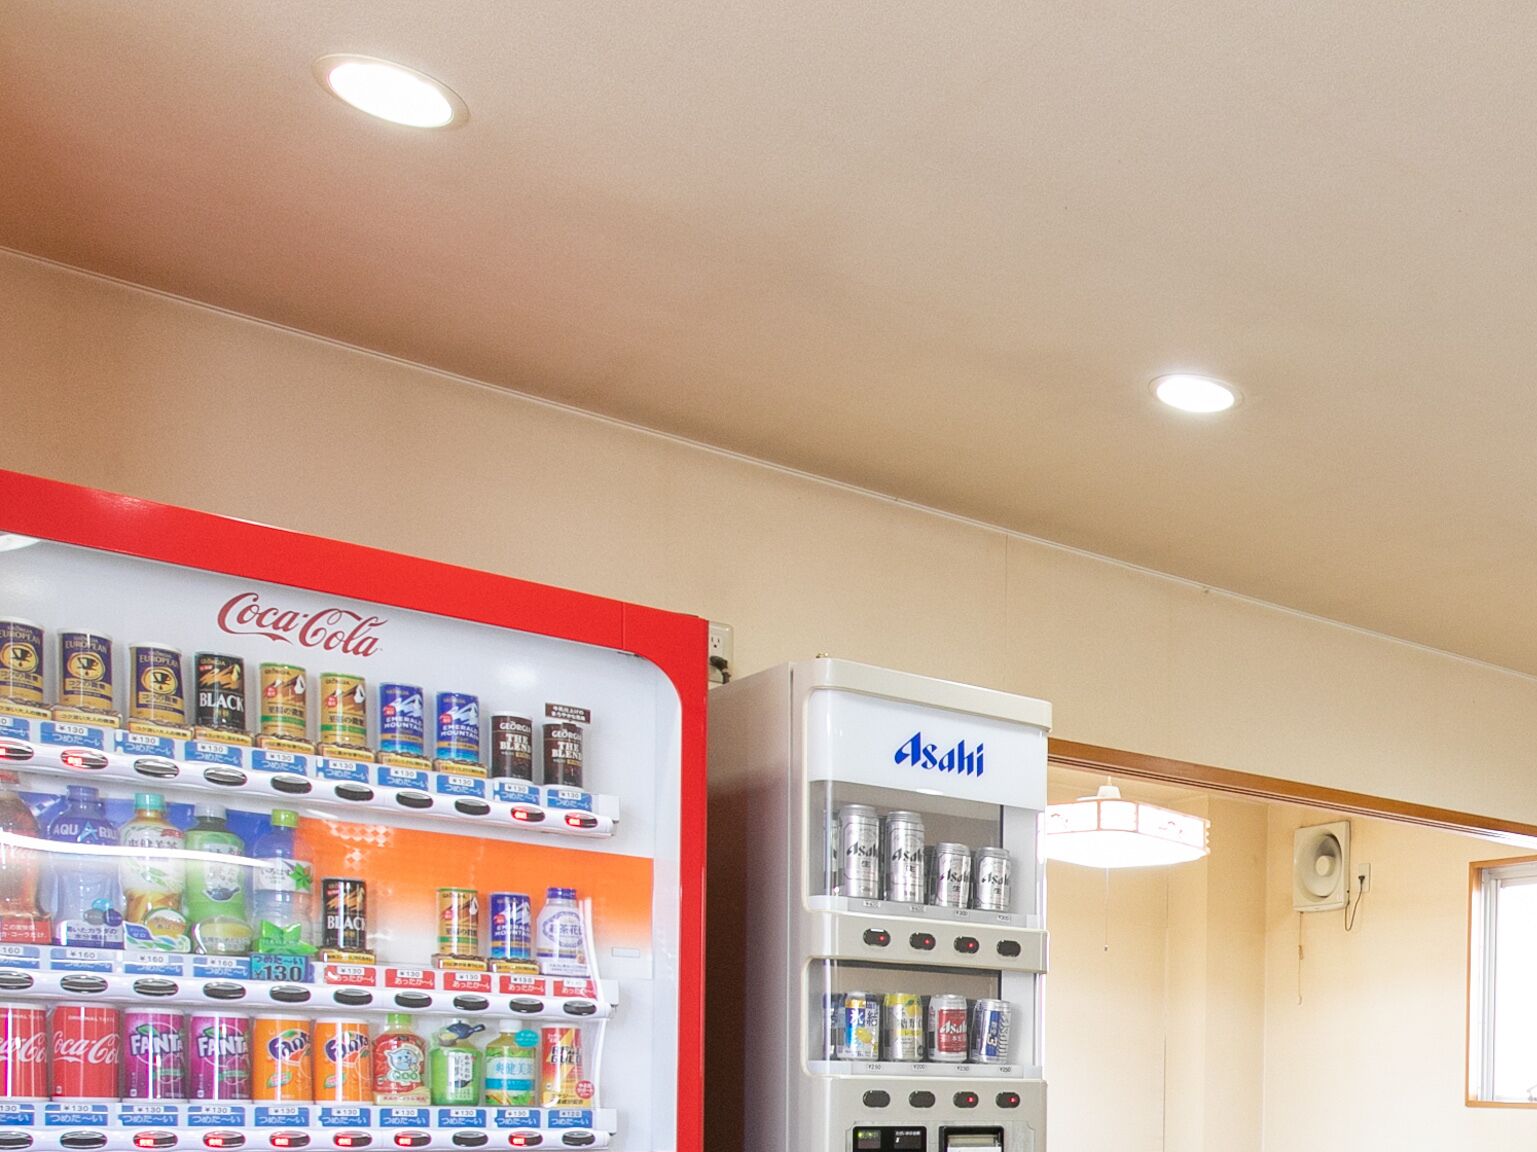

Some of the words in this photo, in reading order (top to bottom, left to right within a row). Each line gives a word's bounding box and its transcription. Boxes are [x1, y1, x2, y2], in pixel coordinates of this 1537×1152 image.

[218, 592, 388, 657] Coca-Cola
[200, 692, 245, 713] BLACK
[505, 733, 529, 744] THE
[557, 741, 579, 752] THE
[894, 731, 984, 778] Asahi
[253, 965, 303, 982] ¥130
[849, 1008, 878, 1026] 氷結
